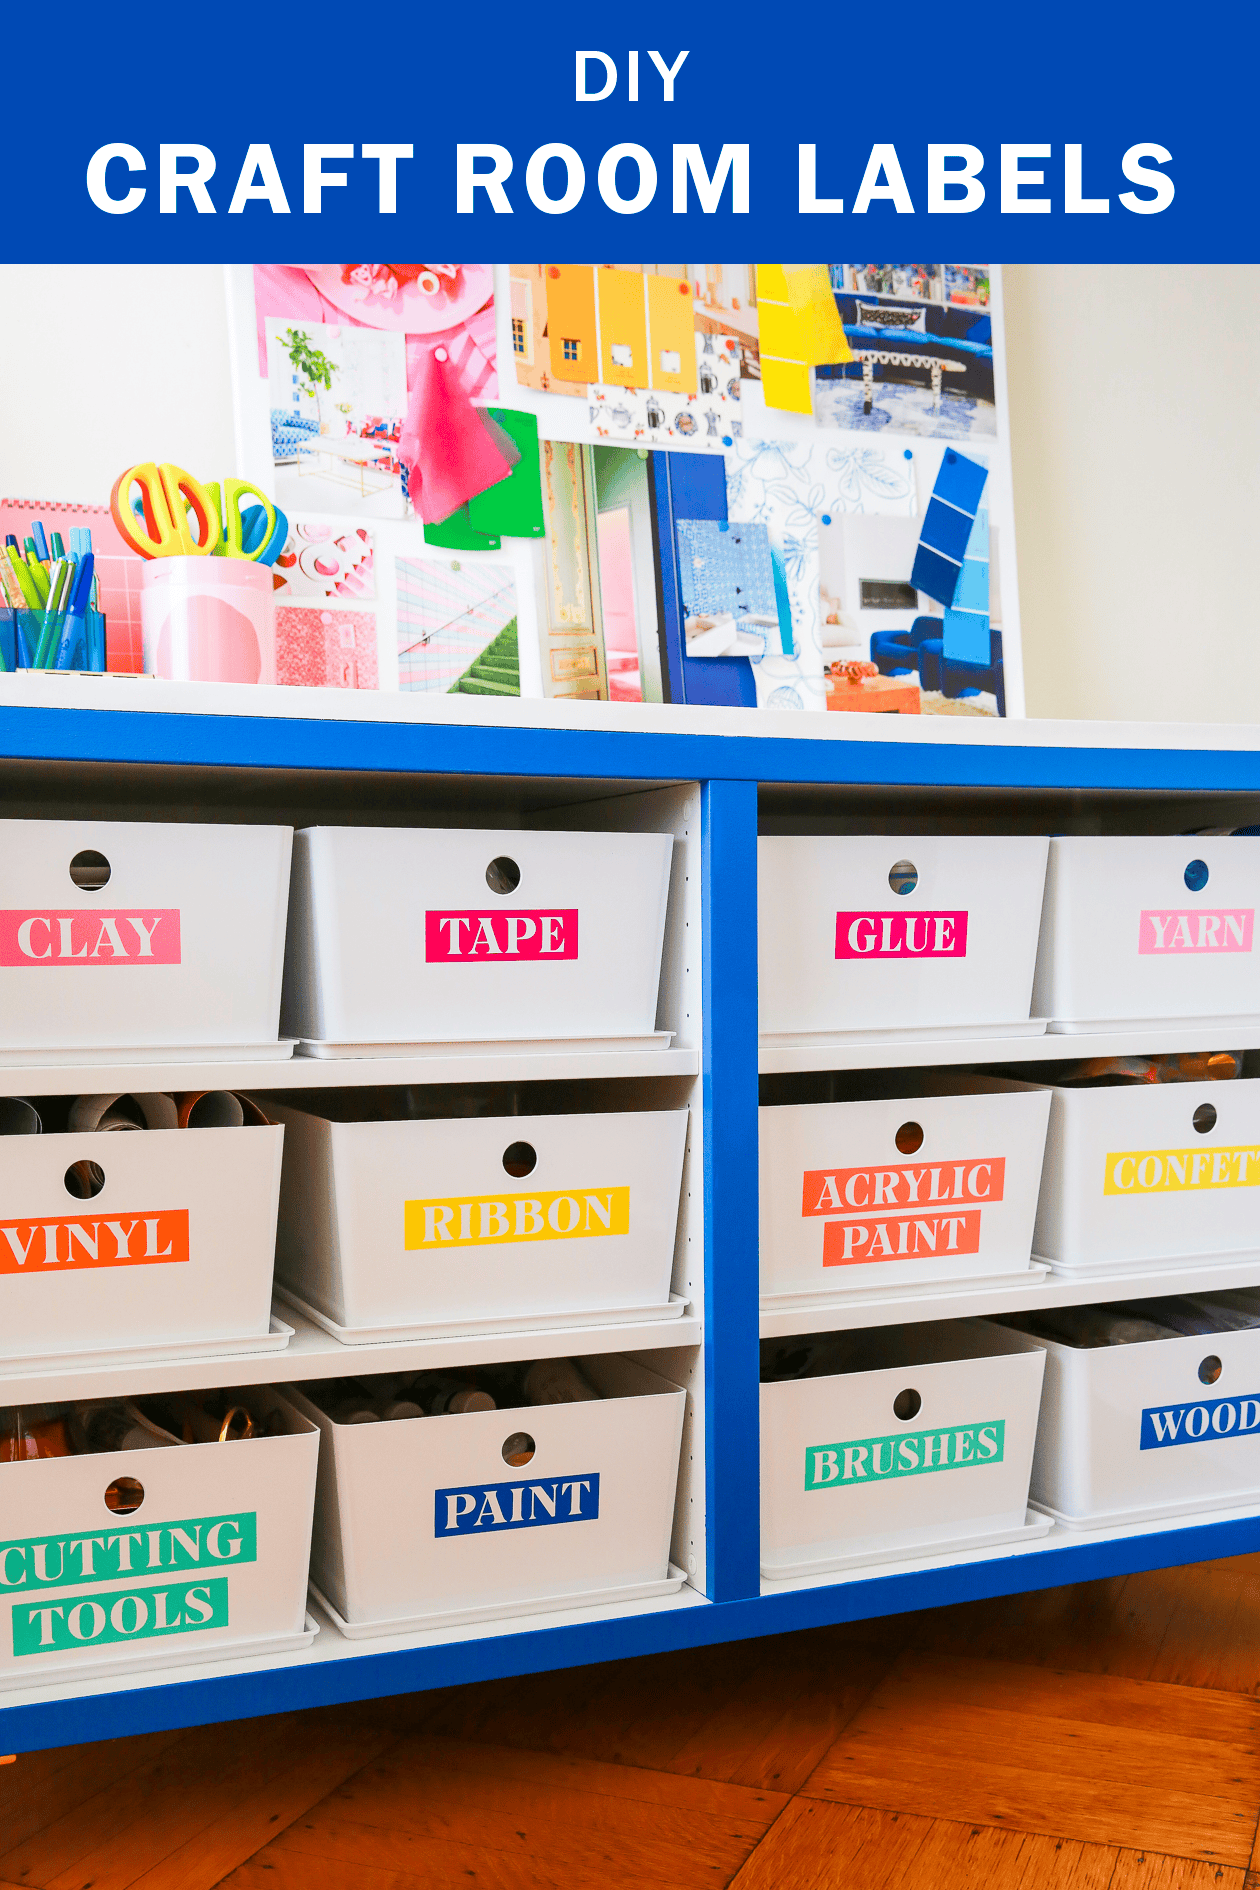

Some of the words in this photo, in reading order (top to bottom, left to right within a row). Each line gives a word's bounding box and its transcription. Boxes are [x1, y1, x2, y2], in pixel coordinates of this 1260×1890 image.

[17, 917, 162, 959] CLAY
[439, 916, 565, 955] TAPE
[847, 917, 956, 953] GLUE
[1148, 914, 1247, 949] YARN
[814, 1164, 991, 1210] ACRYLIC
[1112, 1150, 1260, 1189] CONFET
[423, 1193, 615, 1242] RIBBON
[841, 1218, 966, 1259] PAINT
[0, 1218, 172, 1265] VINYL
[1149, 1400, 1260, 1442] WOOD
[811, 1426, 999, 1484] BRUSHES
[444, 1480, 591, 1530] PAINT
[0, 1521, 244, 1586] CUTTING
[28, 1586, 214, 1646] TOOLS
